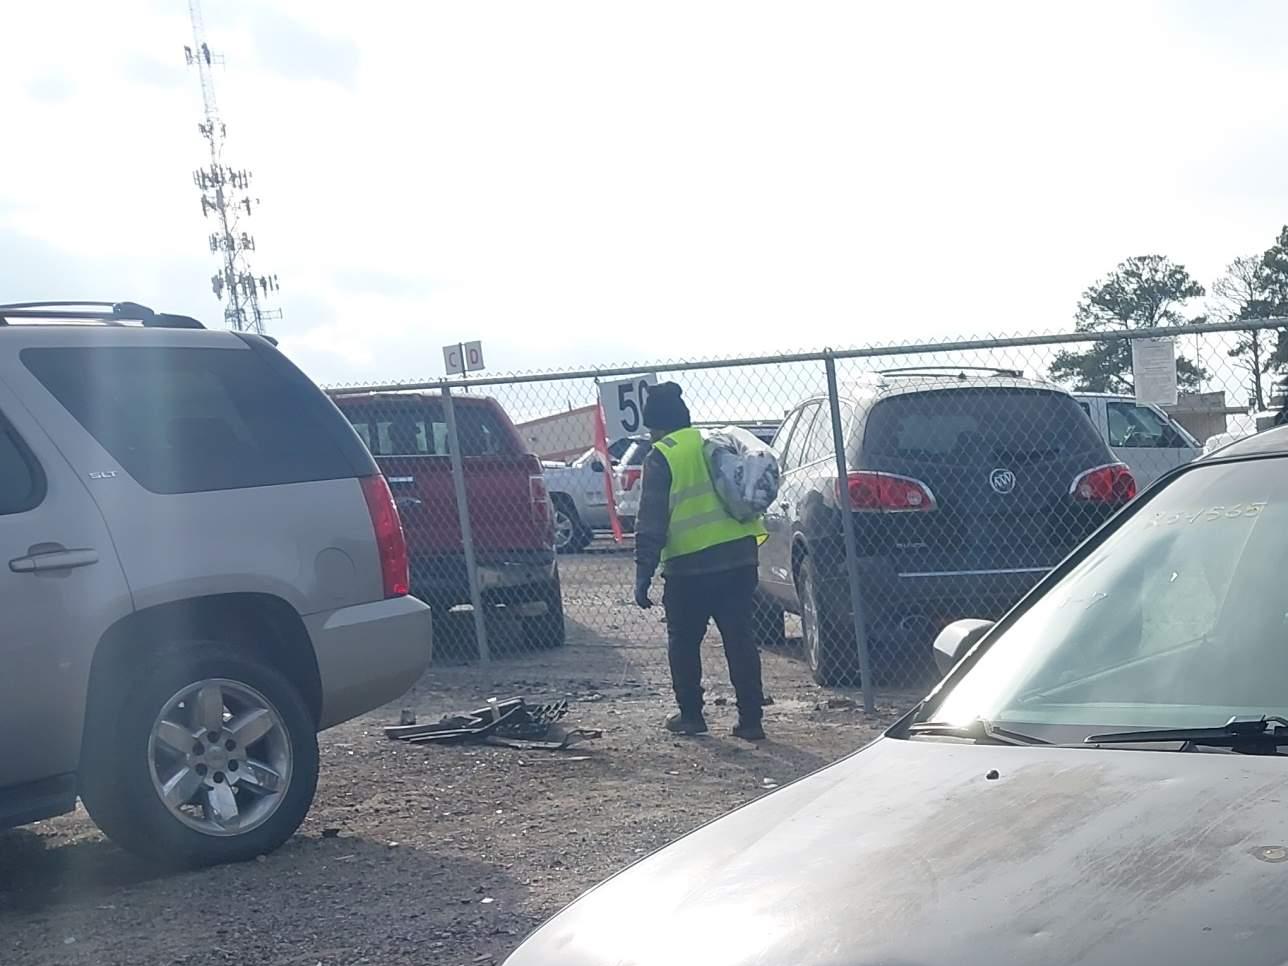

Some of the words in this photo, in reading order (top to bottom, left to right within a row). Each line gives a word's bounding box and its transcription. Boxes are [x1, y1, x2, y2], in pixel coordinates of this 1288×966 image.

[448, 351, 457, 368] C
[470, 348, 479, 365] D
[89, 471, 118, 480] SLT
